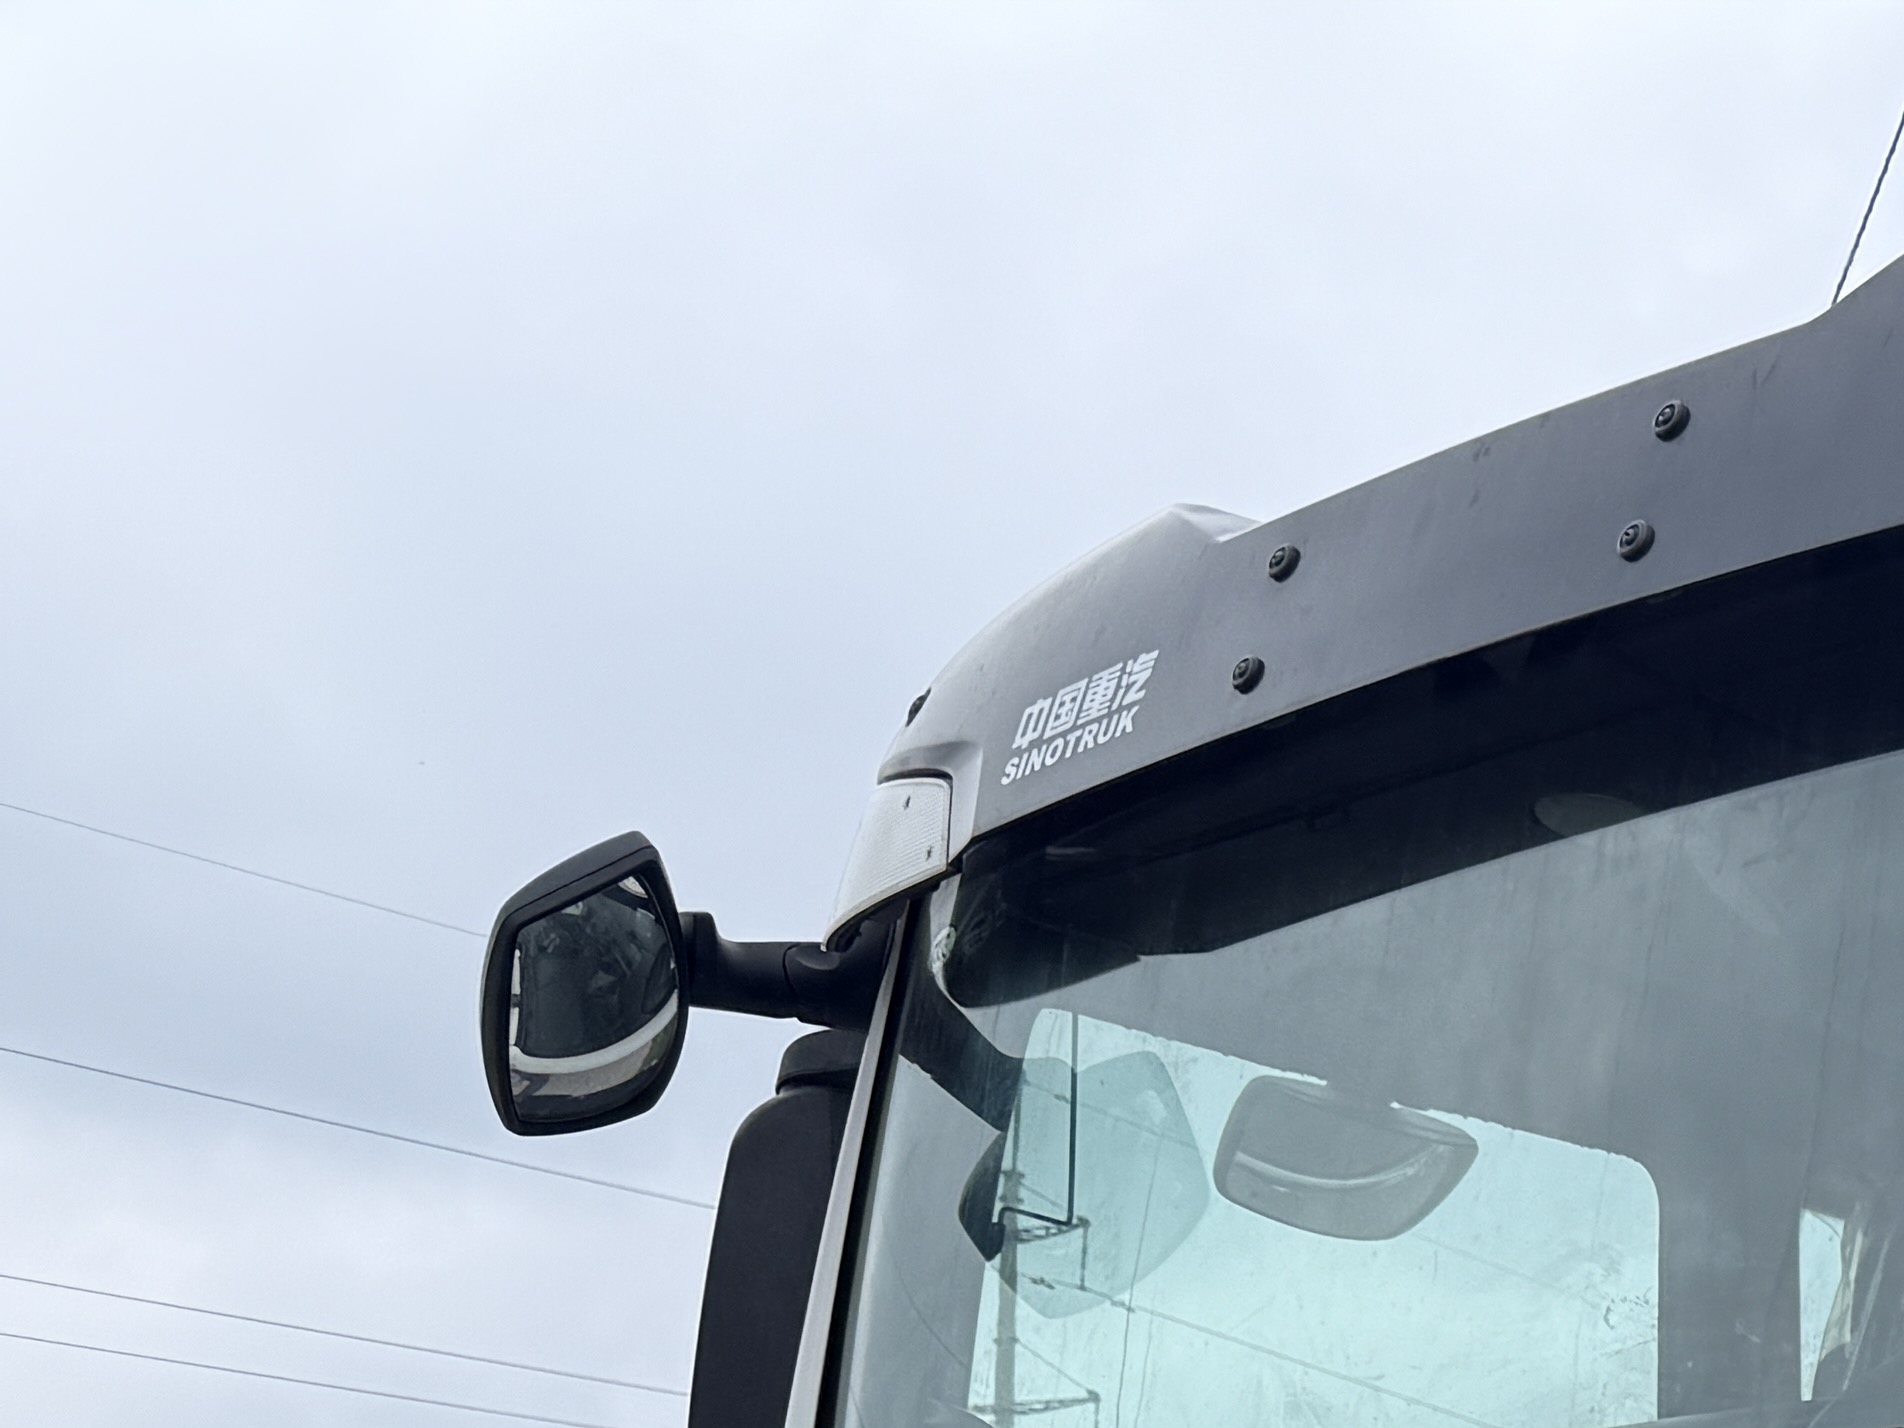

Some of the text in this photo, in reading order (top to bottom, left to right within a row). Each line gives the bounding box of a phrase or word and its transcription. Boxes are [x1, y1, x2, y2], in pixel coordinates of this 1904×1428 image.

[1012, 649, 1160, 750] 中国重汽
[1000, 705, 1140, 786] SINOTRUK
